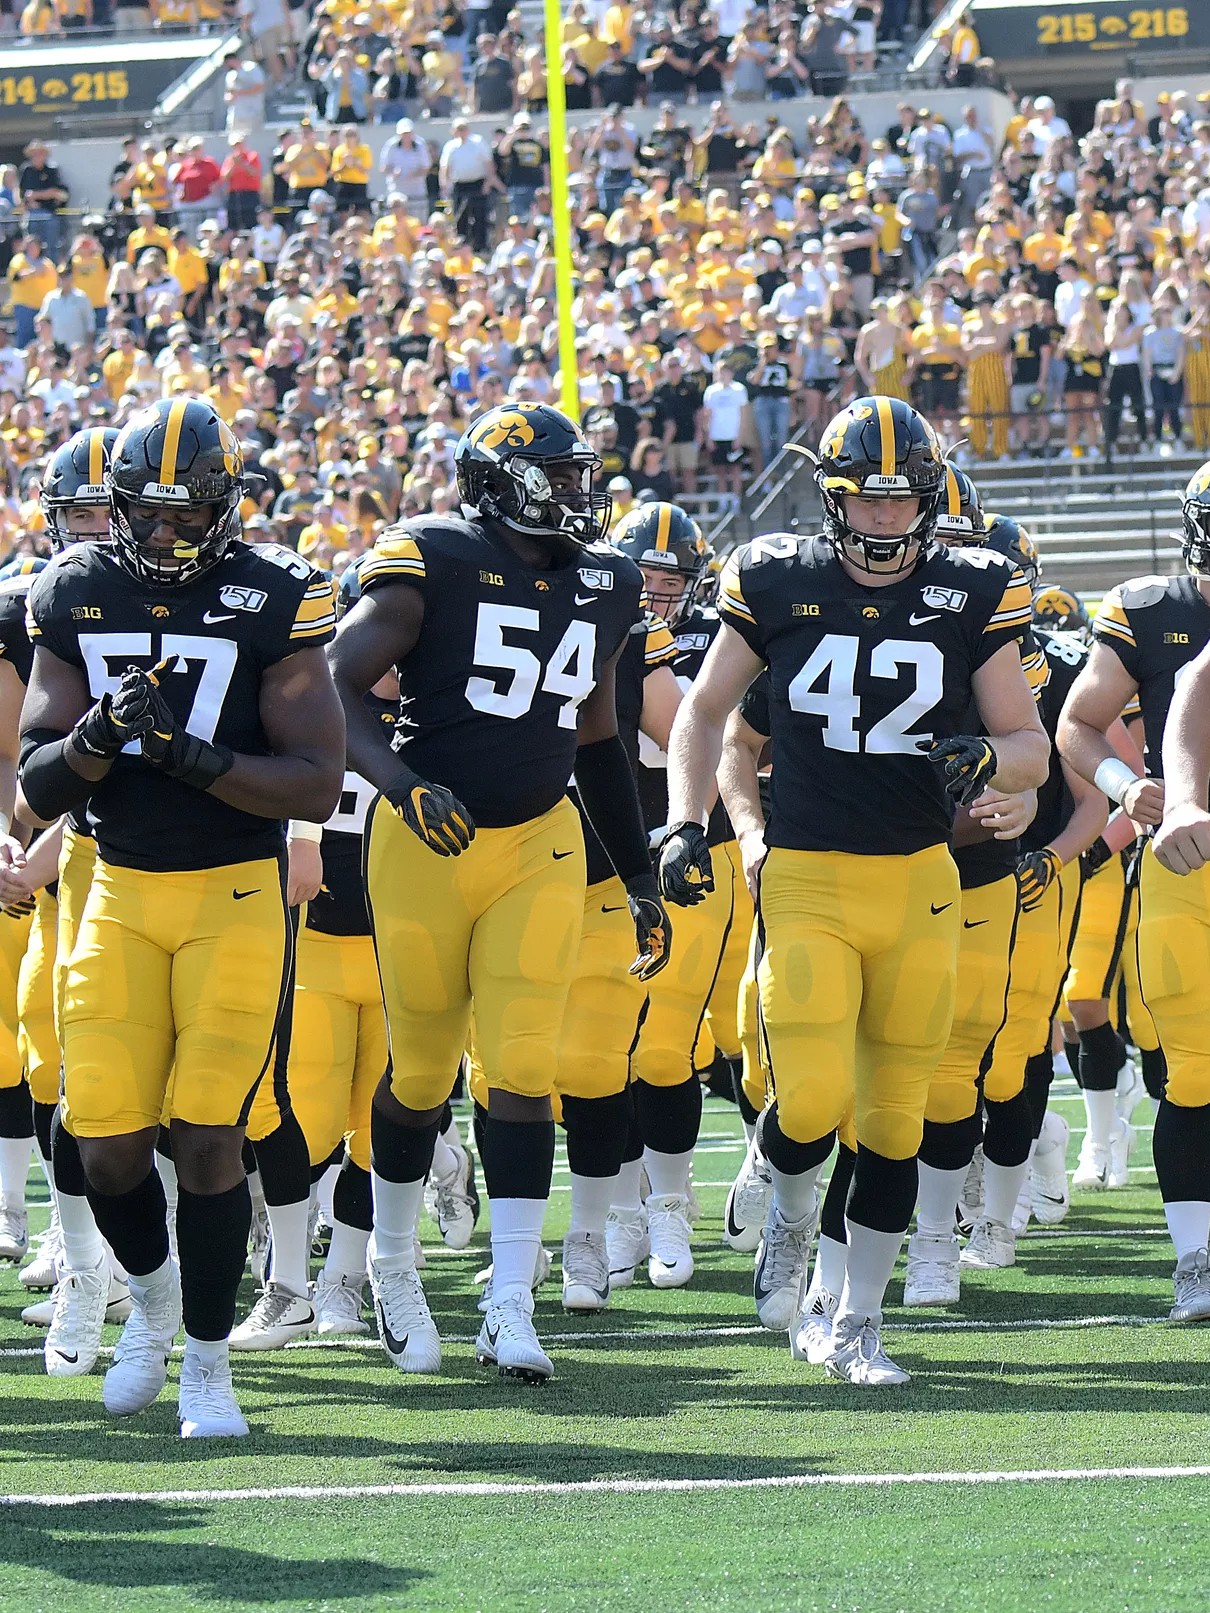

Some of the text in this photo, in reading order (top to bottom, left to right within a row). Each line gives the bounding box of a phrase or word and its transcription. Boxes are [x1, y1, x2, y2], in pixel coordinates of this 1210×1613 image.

[1036, 8, 1189, 44] 215 216
[0, 71, 129, 105] 14 215
[86, 486, 105, 494] IOWA
[156, 485, 177, 495] IOWA
[878, 476, 898, 485] IOWA
[947, 515, 964, 525] IOWA
[577, 568, 614, 591] 150
[219, 585, 268, 613] 150
[920, 585, 968, 613] 150
[464, 602, 597, 730] 54
[78, 633, 238, 756] 57
[788, 633, 945, 757] 42
